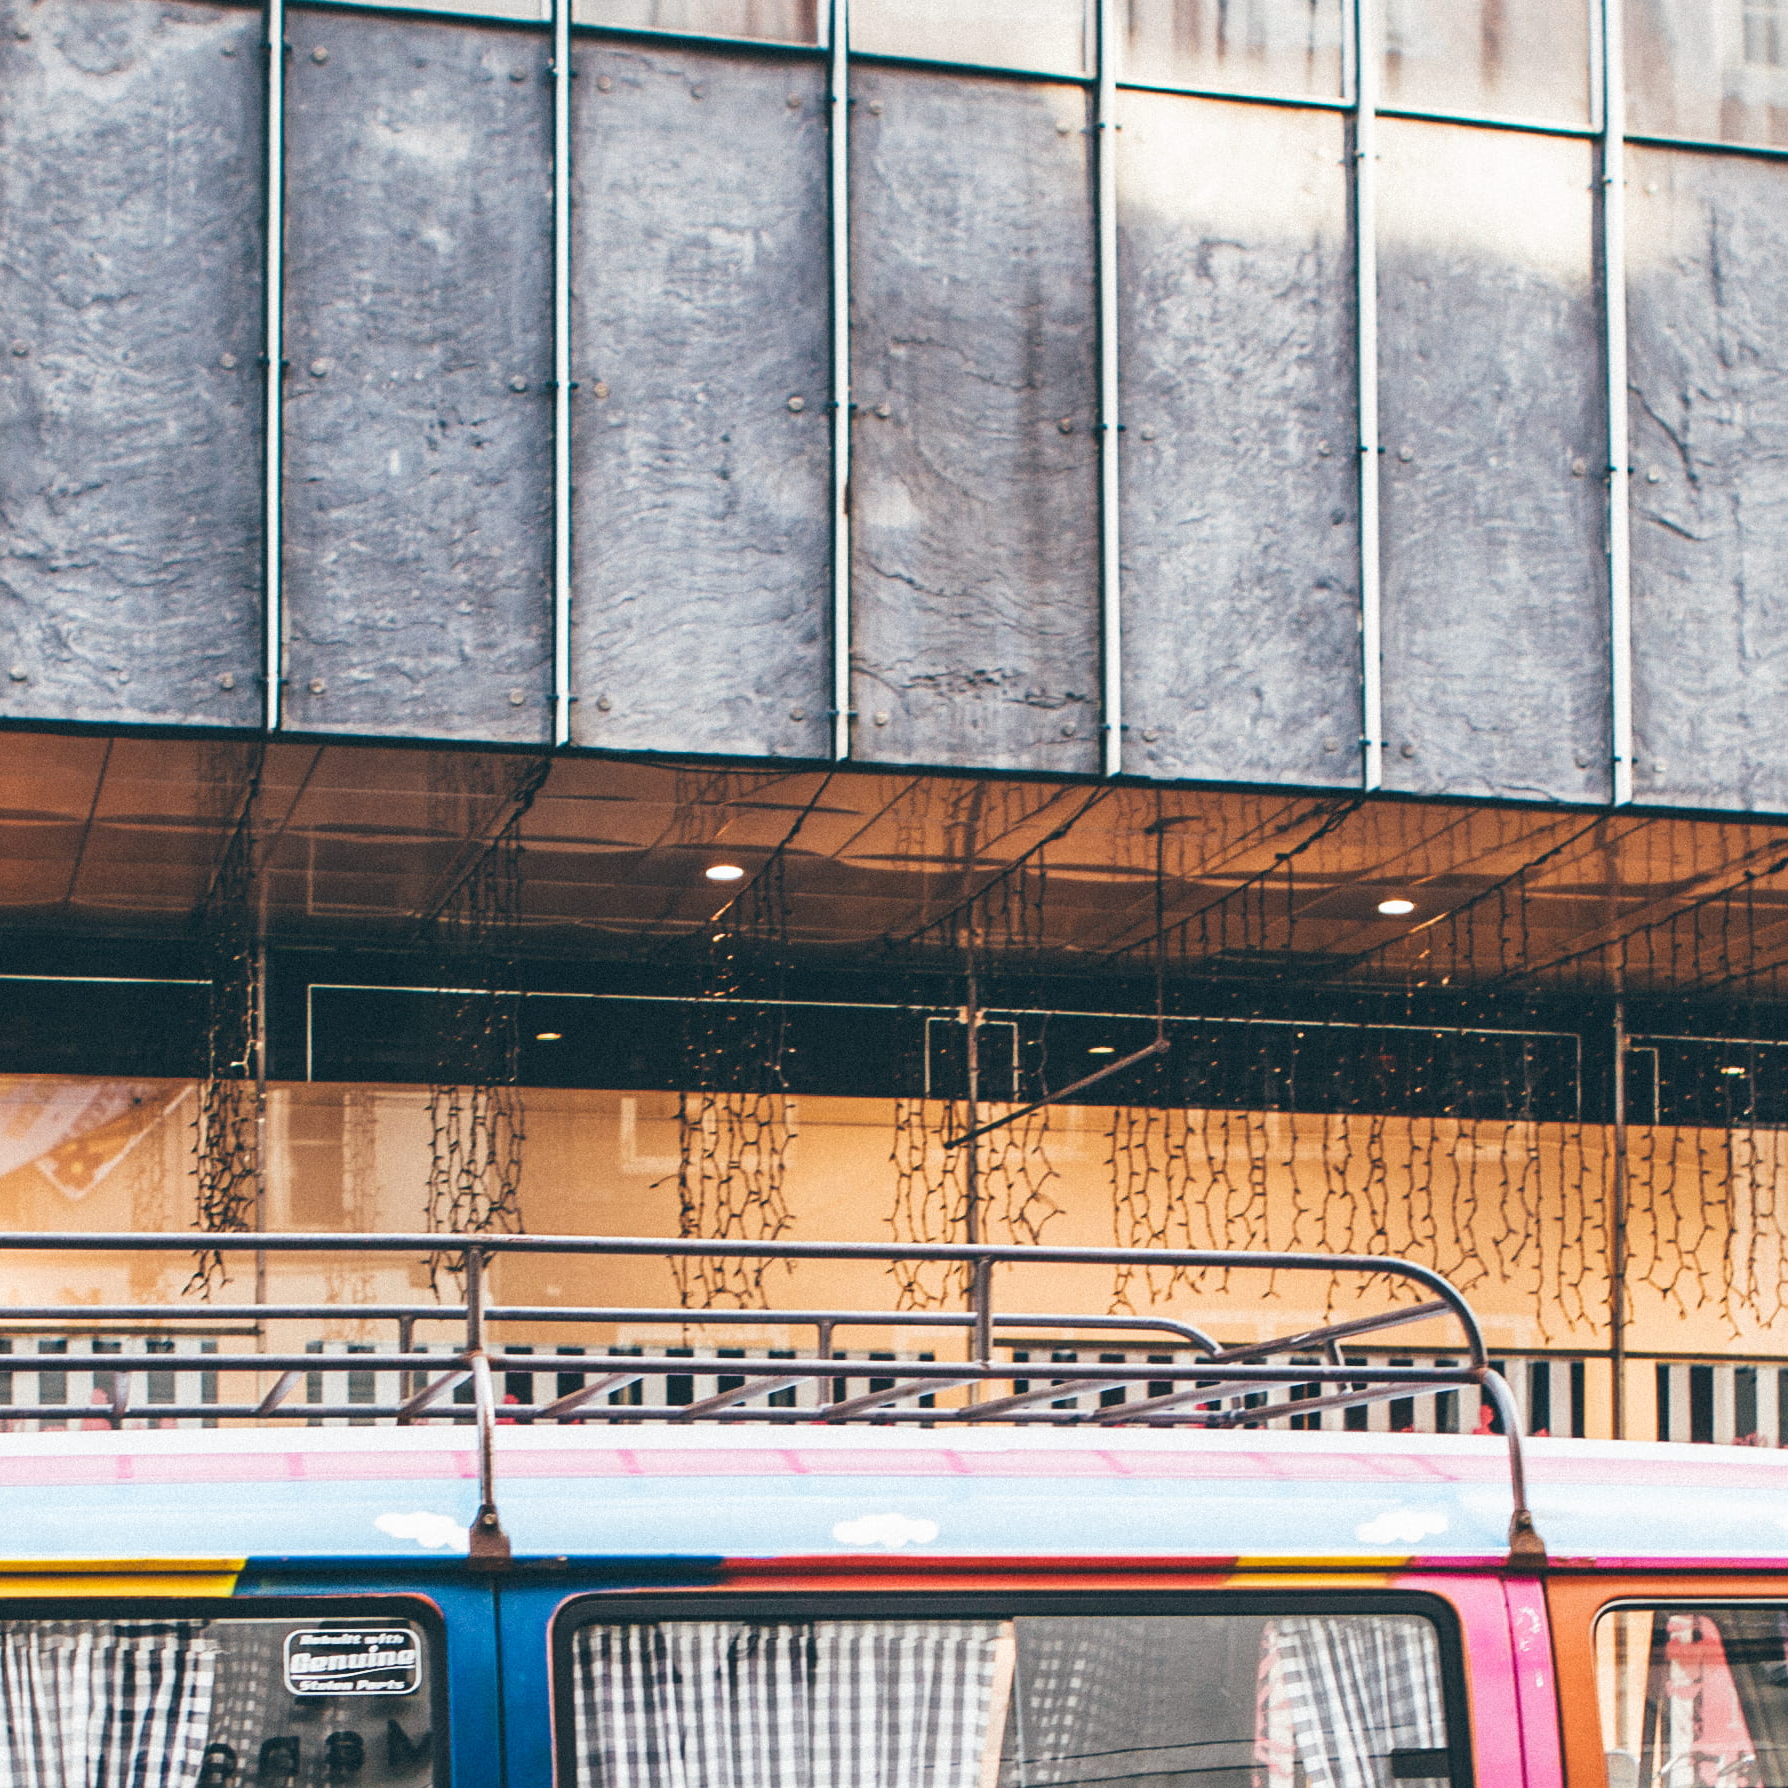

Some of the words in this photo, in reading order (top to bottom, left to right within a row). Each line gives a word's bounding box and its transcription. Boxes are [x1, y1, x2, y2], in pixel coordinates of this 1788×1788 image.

[364, 1633, 405, 1645] with
[290, 1645, 416, 1674] Genuine
[299, 1680, 354, 1692] Stolen
[356, 1679, 406, 1691] Parts
